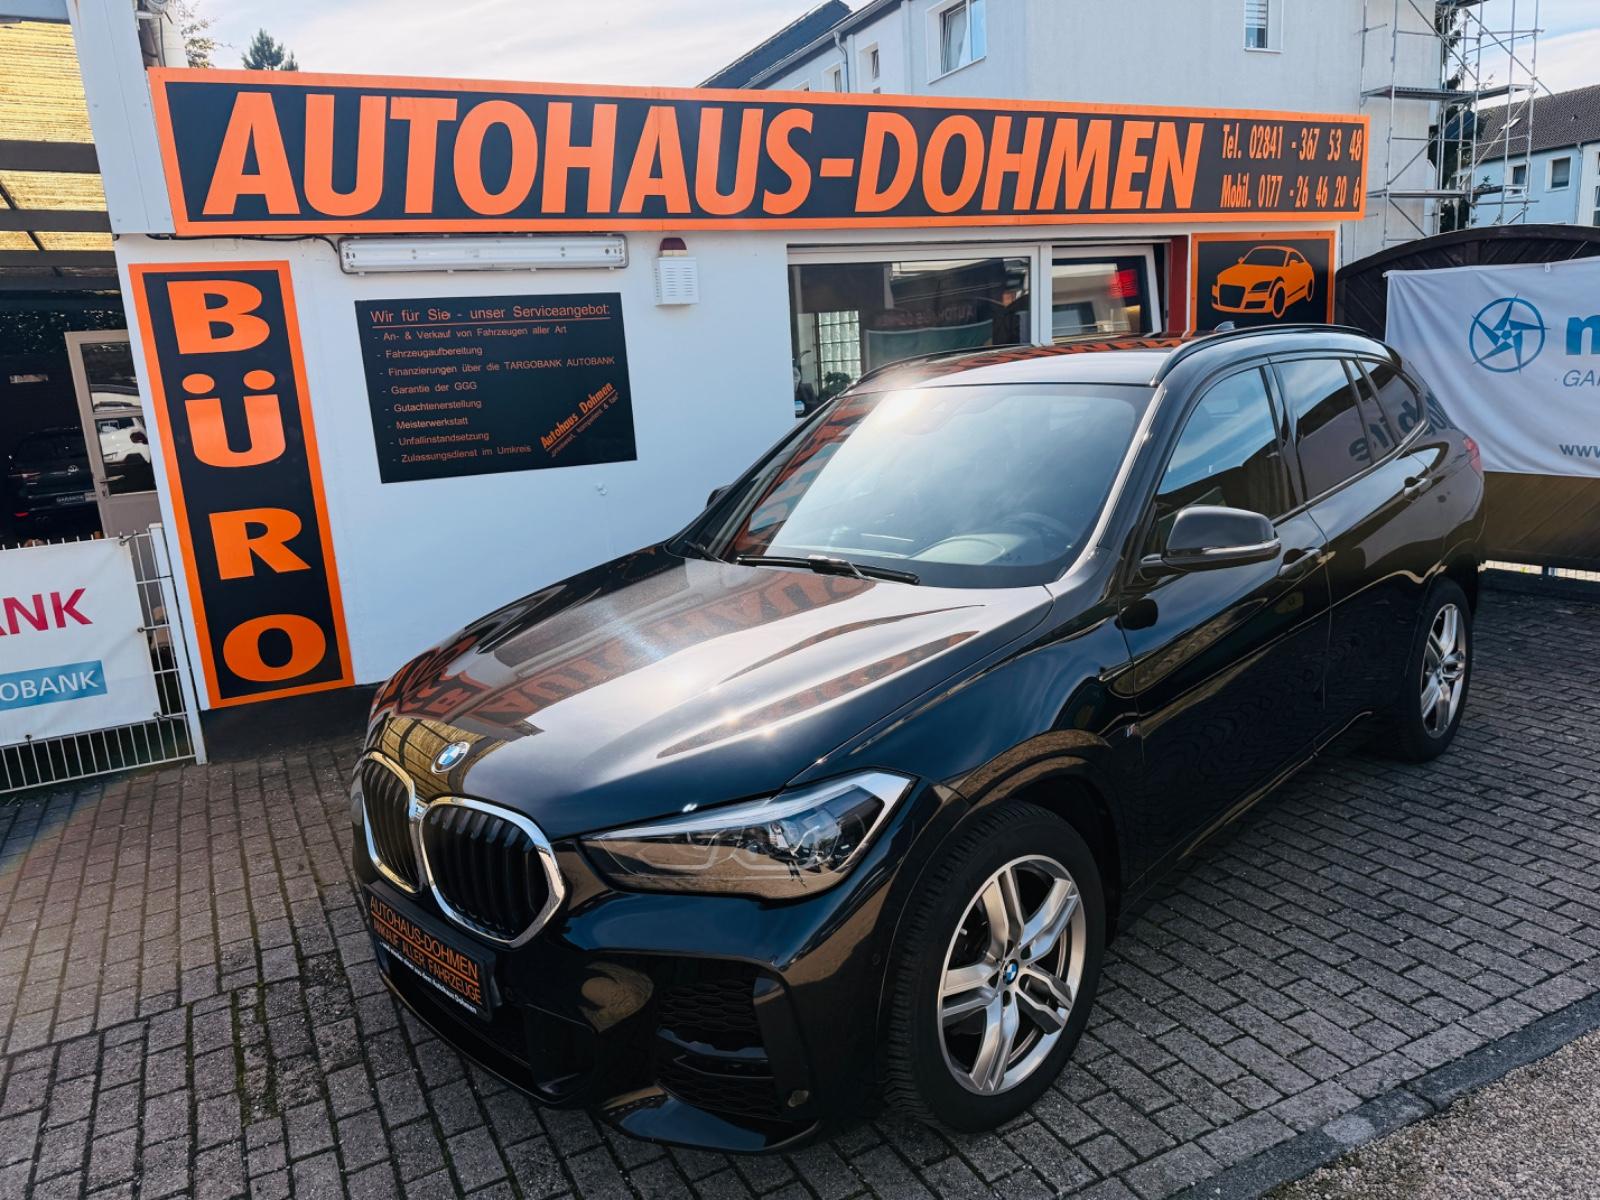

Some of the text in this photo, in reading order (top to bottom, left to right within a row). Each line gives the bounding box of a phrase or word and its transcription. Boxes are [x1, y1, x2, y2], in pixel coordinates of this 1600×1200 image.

[1222, 123, 1242, 159] Tel.
[1249, 125, 1284, 159] 02841
[1327, 128, 1342, 160] 53
[1349, 129, 1362, 160] 48
[202, 91, 1205, 217] AUTOHAUS-DOHMEN
[1220, 173, 1251, 208] Mobil.
[1258, 174, 1283, 208] 0177
[1315, 176, 1329, 208] 46
[1333, 176, 1347, 208] 20
[1353, 176, 1360, 208] 6
[370, 310, 394, 322] Wir
[401, 308, 420, 322] für
[427, 307, 450, 320] Sie
[470, 308, 506, 319] unser
[383, 324, 567, 341] An- & Verkauf von Fahrzeugen aller Art
[385, 346, 483, 359] Fahrzeugaufbereitung
[388, 356, 615, 377] Finanzierungen über die TARGOBANK AUTOBANK
[390, 381, 478, 395] Garantie der GGG
[1563, 369, 1600, 388] GA
[393, 399, 482, 413] Gutachtenerstellung
[540, 412, 579, 449] Autohaus
[578, 382, 613, 414] Dohmen
[396, 416, 469, 430] Meisterwerkstatt
[398, 432, 490, 446] Unfallinstandsetzung
[401, 444, 532, 463] Zulassungsdienst im Umkreis
[166, 279, 326, 682] BÜRO
[0, 588, 93, 636] NK
[370, 895, 478, 980] AUTOHAUS-DOHMEN
